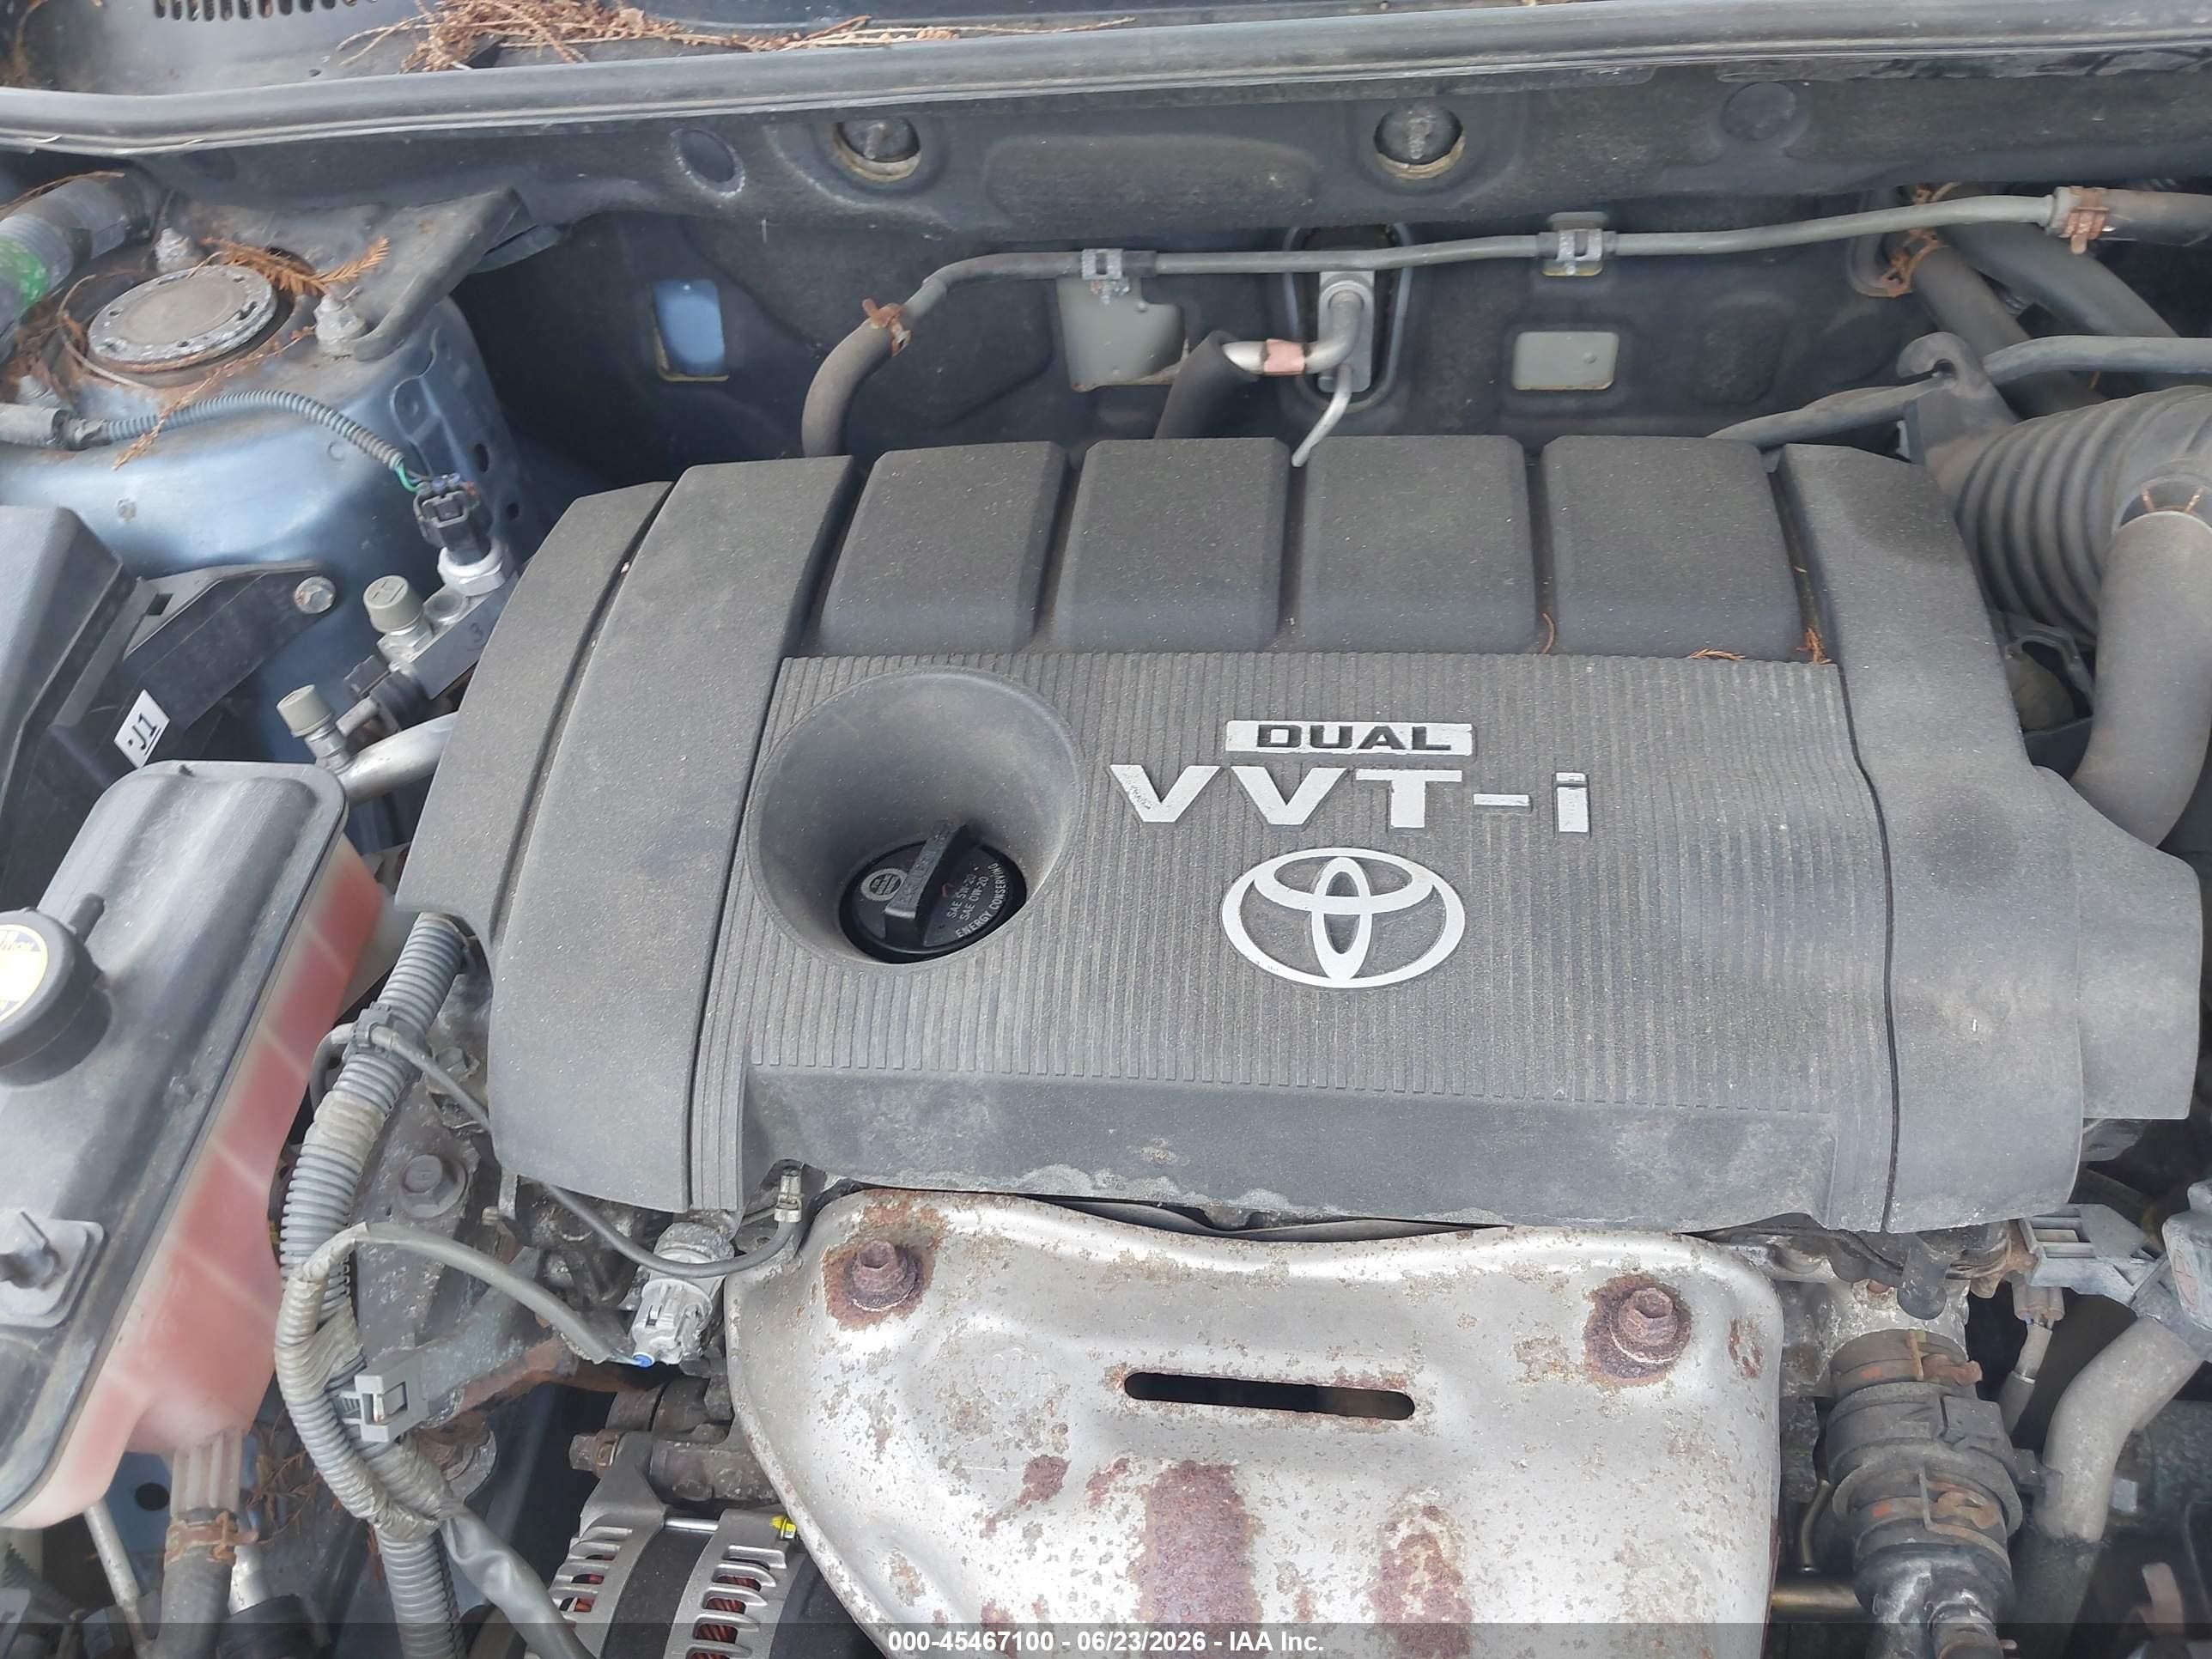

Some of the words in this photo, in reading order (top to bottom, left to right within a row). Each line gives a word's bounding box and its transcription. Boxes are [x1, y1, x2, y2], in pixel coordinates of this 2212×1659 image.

[1256, 724, 1452, 751] DUAL
[1109, 763, 1589, 834] VVT-i
[946, 900, 962, 919] SAE
[955, 910, 993, 938] ENERGY
[988, 862, 1006, 910] CONSERVING
[959, 902, 975, 921] SAE
